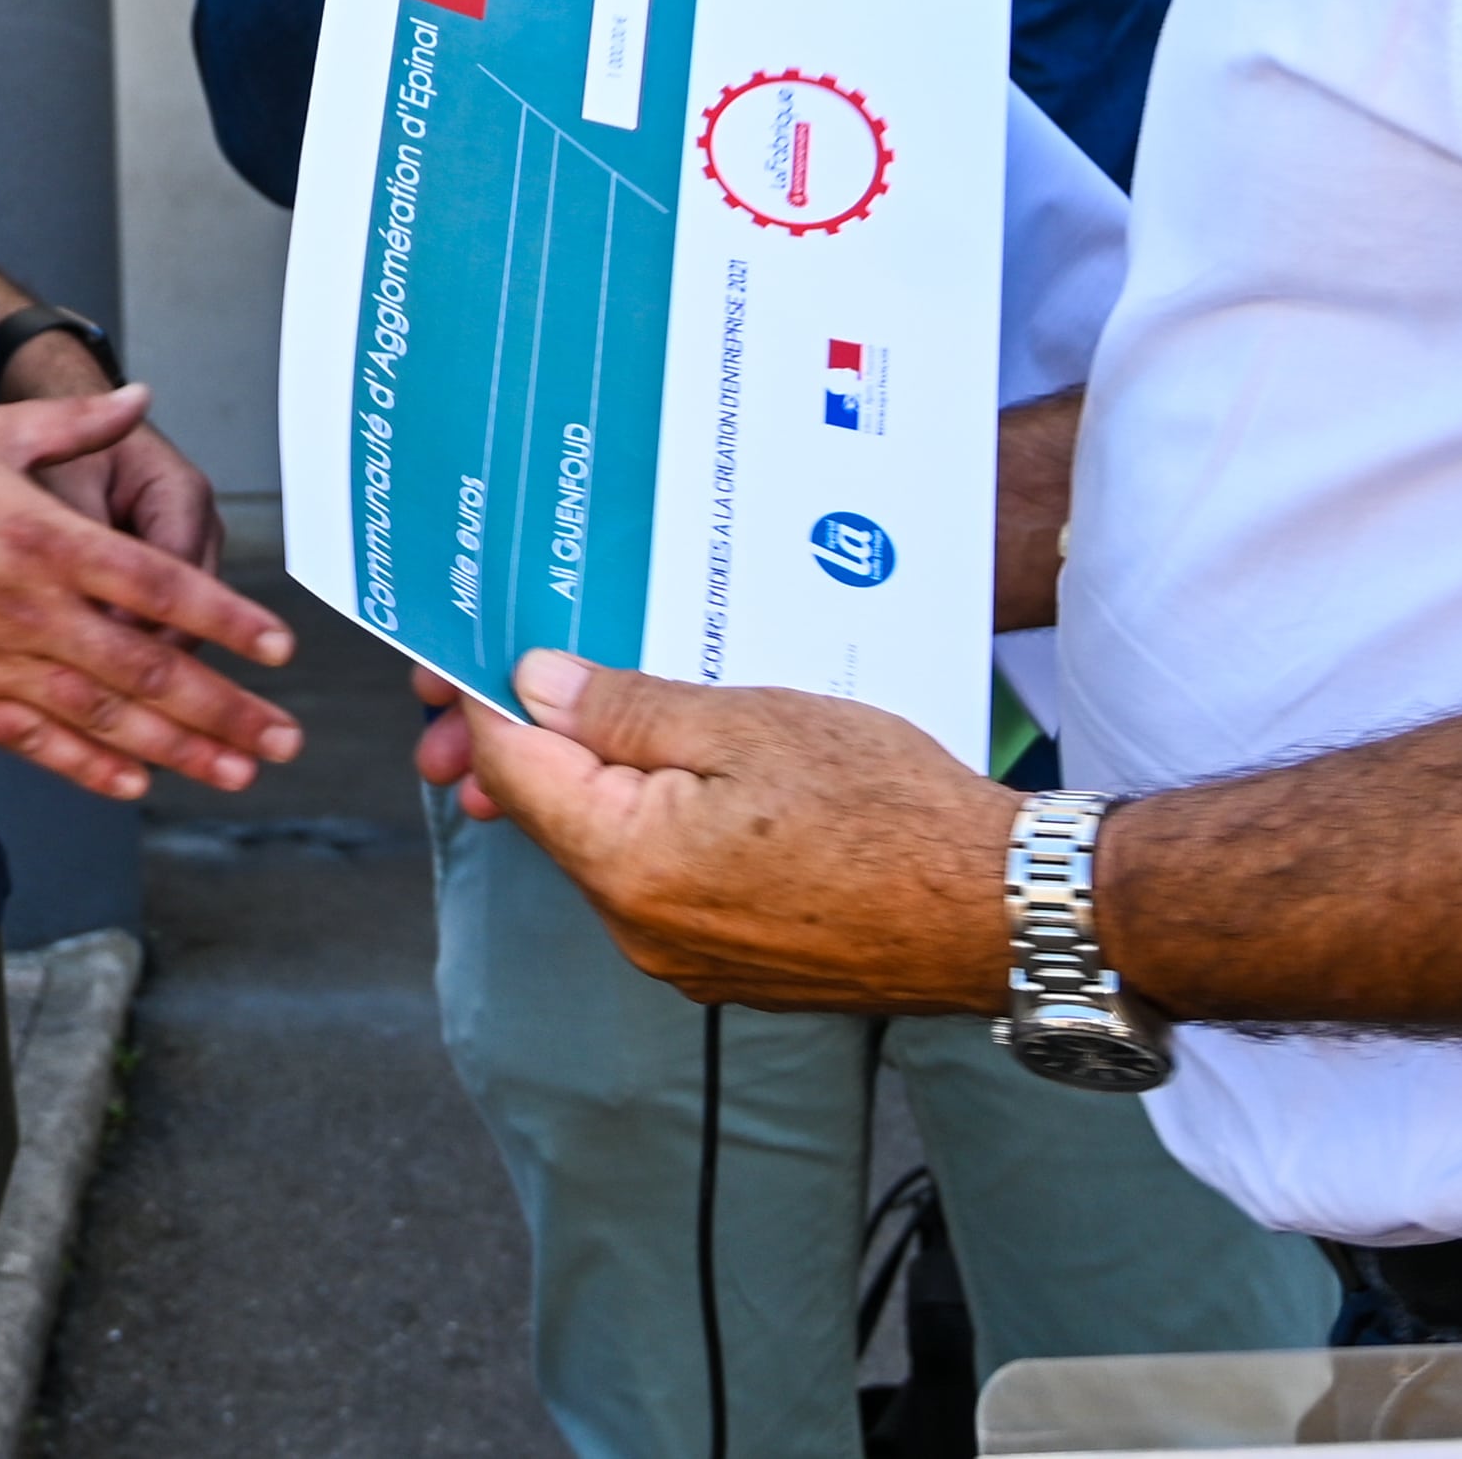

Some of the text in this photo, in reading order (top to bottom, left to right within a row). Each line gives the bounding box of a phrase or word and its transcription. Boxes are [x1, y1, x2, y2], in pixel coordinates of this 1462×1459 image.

[359, 16, 439, 632] Communauté d'Agglomération d'Epinal
[727, 258, 748, 293] 2021
[718, 294, 746, 409] D'ENTREPRISE
[712, 498, 734, 520] LA
[713, 410, 739, 493] CREATION
[449, 474, 485, 619] Mille euros
[548, 422, 592, 602] Ali GUENFOUD
